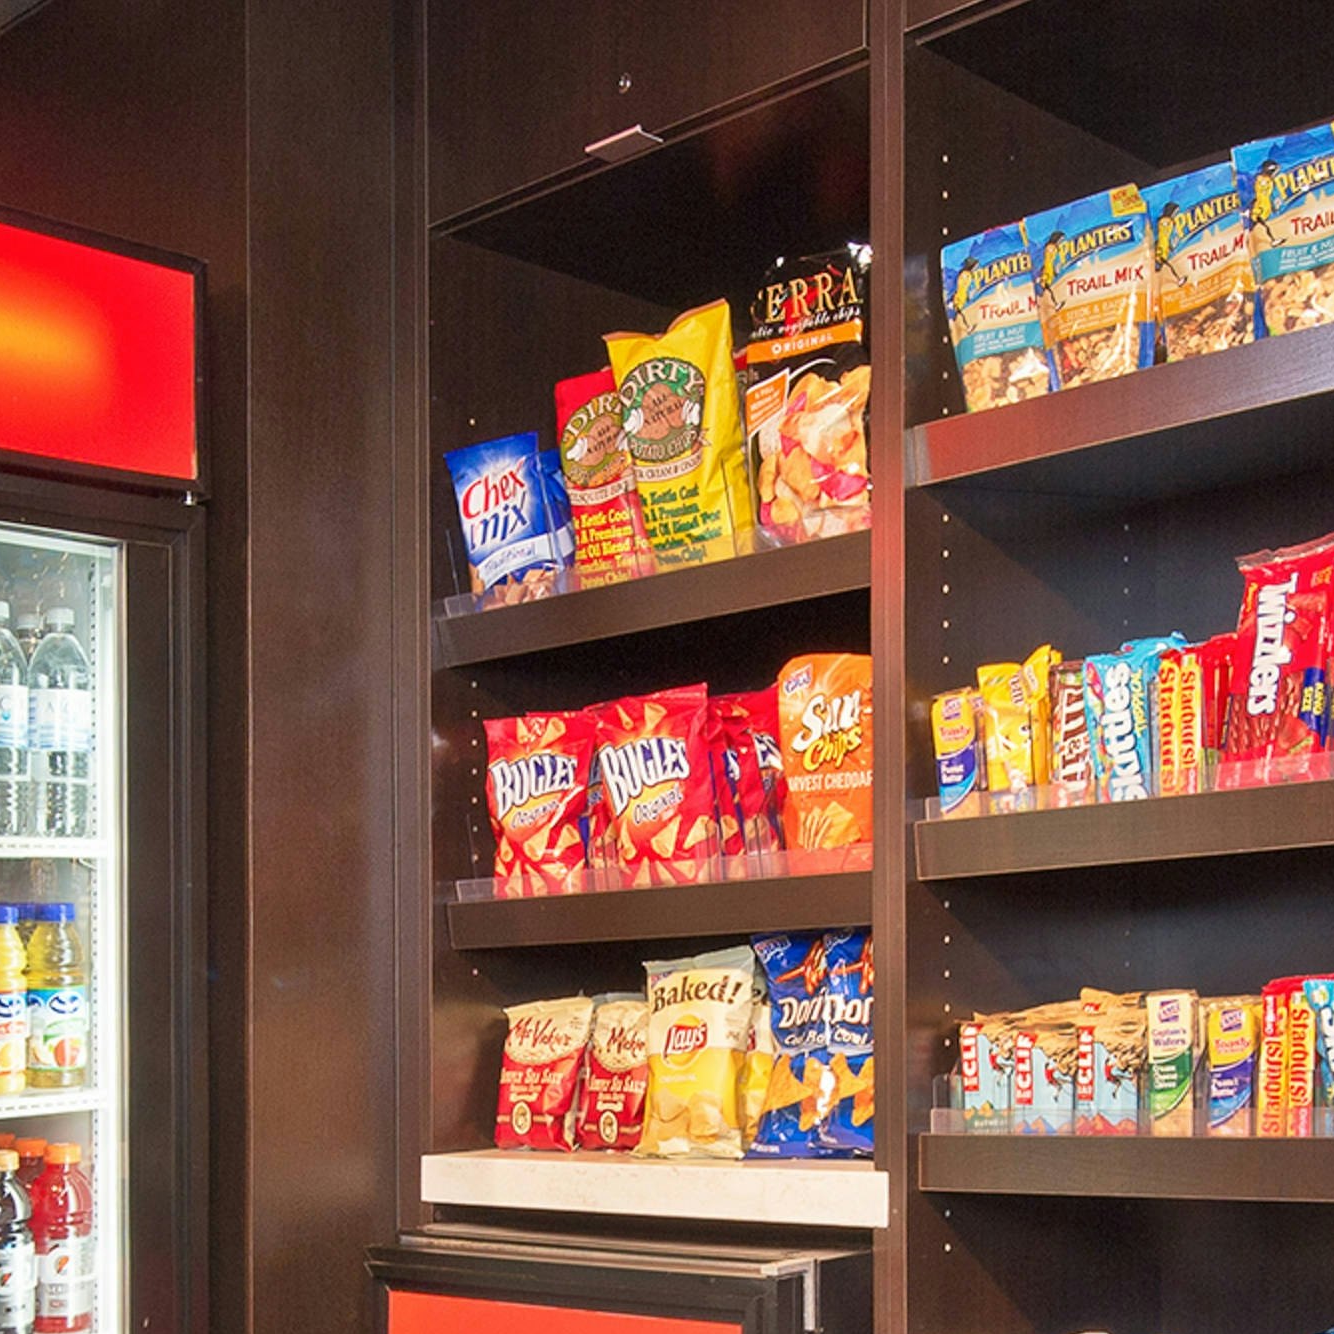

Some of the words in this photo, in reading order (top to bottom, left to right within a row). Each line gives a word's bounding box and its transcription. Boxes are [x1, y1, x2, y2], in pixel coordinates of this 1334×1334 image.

[1176, 190, 1240, 235] PLANTER
[1059, 223, 1133, 264] PLANTERS
[1188, 242, 1228, 270] TRAIL
[762, 266, 859, 323] ERRA
[973, 253, 1031, 290] PLANTE
[1068, 274, 1111, 295] TRAIL
[1114, 265, 1144, 284] MIX
[979, 301, 1025, 319] TRAIL
[772, 333, 833, 353] ORIGINAL
[620, 360, 704, 407] DIRTY
[462, 454, 527, 520] Chex
[468, 491, 528, 552] mix
[1247, 572, 1299, 716] Twizzlers
[792, 691, 860, 753] Sun
[1104, 661, 1150, 800] Skittles
[1180, 670, 1197, 770] Starburst
[803, 725, 863, 771] Chips
[490, 752, 578, 820] BUGLES
[599, 737, 690, 816] BUGLES
[651, 974, 744, 1013] Baked!
[667, 1024, 707, 1054] Lay's
[1018, 1033, 1035, 1082] CLIF
[1078, 1027, 1094, 1082] CLIF
[1290, 1008, 1309, 1106] Starburst
